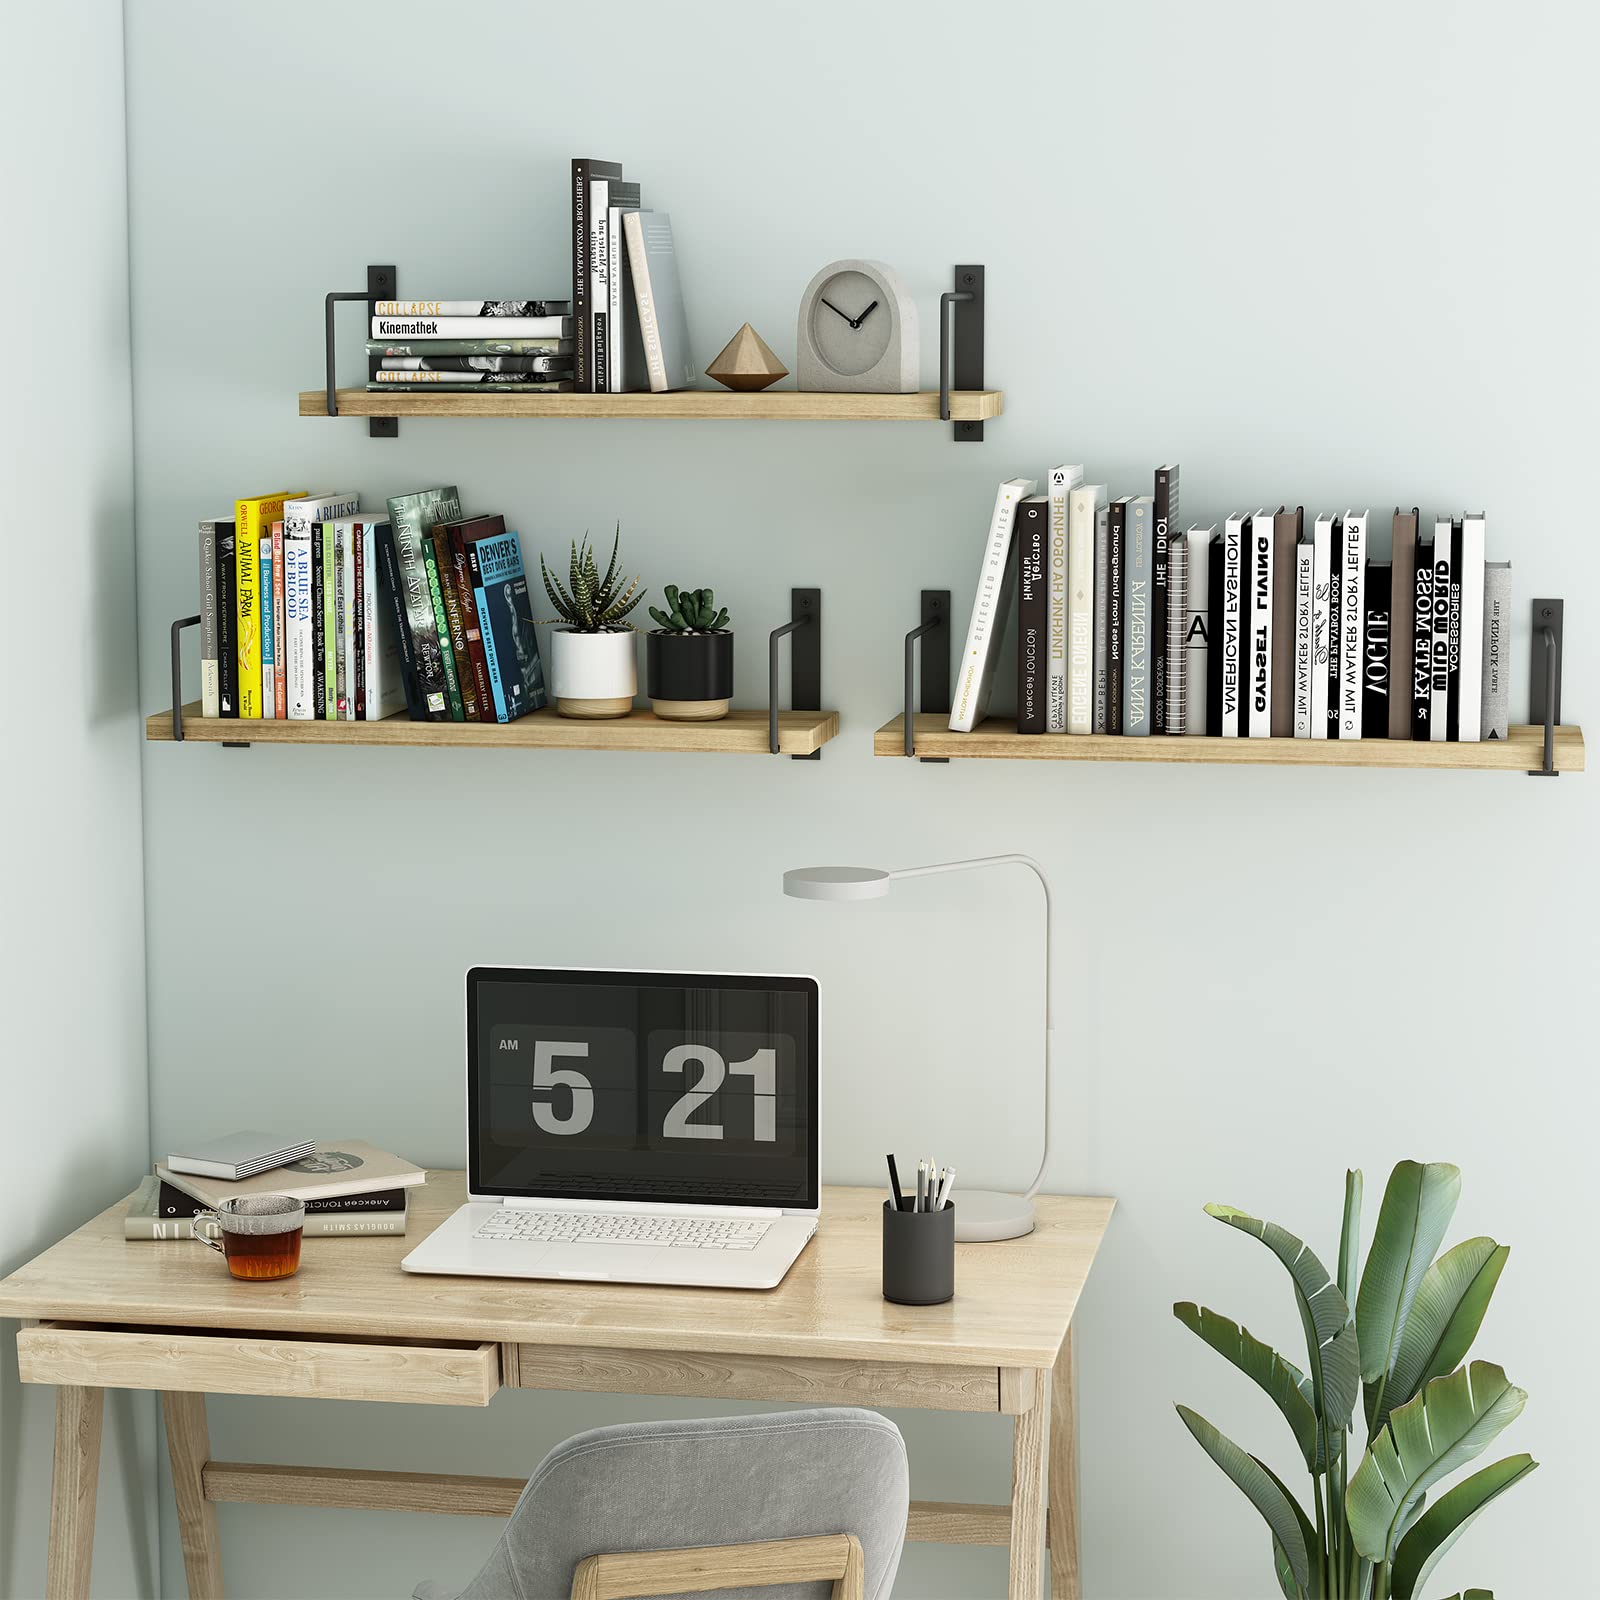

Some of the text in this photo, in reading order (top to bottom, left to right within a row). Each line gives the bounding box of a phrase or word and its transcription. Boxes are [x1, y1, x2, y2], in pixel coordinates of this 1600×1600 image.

[378, 302, 442, 315] COLLAPSE
[380, 321, 438, 334] Kinemathek
[378, 371, 442, 382] COLLAPSE
[204, 538, 212, 565] Quaker
[314, 528, 322, 558] paul green
[335, 529, 343, 548] Viking
[480, 538, 517, 563] DENVER'S
[205, 567, 213, 591] School
[239, 540, 253, 618] ANIMAL FARM
[394, 504, 425, 628] THE NINTH AVATAR
[454, 553, 467, 584] Degrees
[483, 564, 495, 575] BEST
[495, 560, 506, 572] DIVE
[508, 556, 519, 567] BARS
[287, 552, 296, 619] OF BLOOD
[297, 549, 308, 621] A BLUE SEA
[206, 594, 214, 609] Girl
[205, 612, 215, 643] Samplers
[264, 615, 272, 652] Production
[447, 599, 464, 650] INFERNO
[480, 608, 488, 636] DENVER'S
[1186, 615, 1208, 642] A
[367, 632, 372, 642] NO
[421, 643, 433, 681] NEWTON
[475, 662, 488, 711] KIMBERLY FLEEK
[499, 1039, 518, 1050] AM
[531, 1040, 777, 1142] 5 21
[343, 1199, 390, 1207] Алексей
